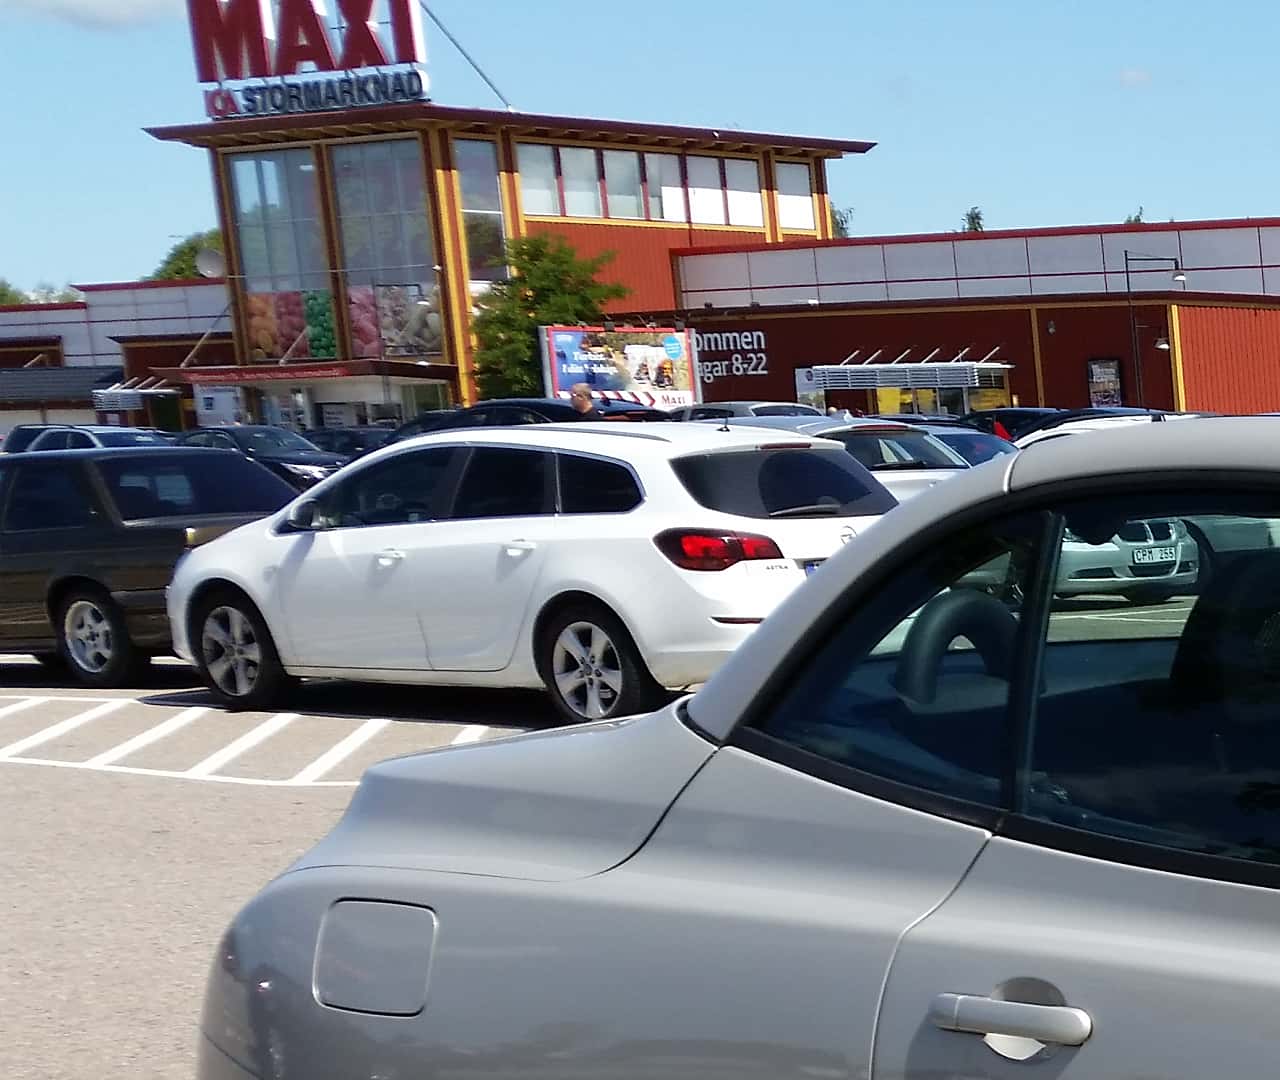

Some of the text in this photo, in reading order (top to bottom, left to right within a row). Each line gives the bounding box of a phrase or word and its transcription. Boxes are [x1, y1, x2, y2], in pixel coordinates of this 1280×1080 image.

[186, 0, 424, 83] MAXI
[242, 71, 424, 114] STORMARKNAD
[731, 353, 768, 376] 8-22
